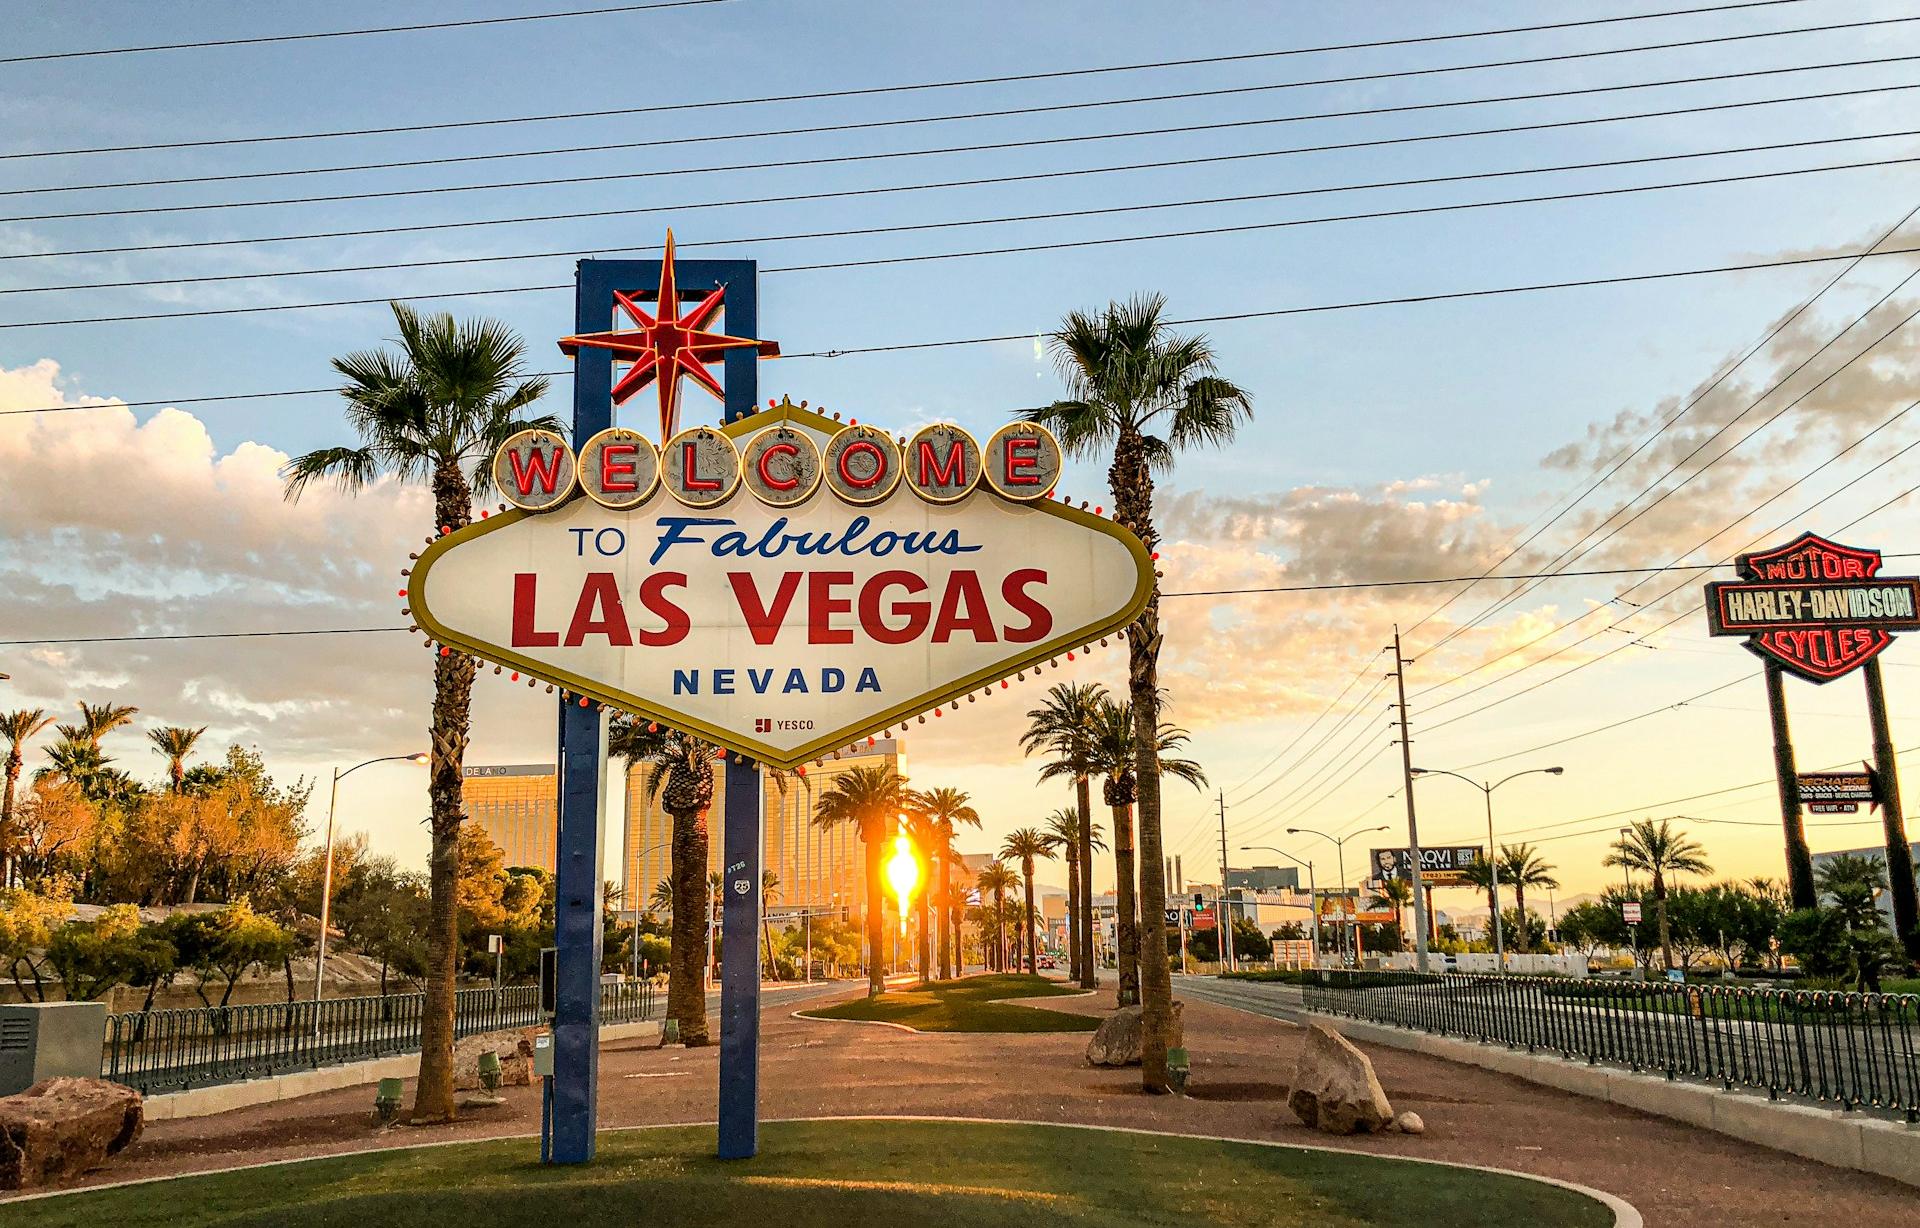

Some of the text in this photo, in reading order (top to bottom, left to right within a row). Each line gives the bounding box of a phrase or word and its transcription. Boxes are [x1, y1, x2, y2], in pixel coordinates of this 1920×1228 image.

[508, 439, 1041, 496] WELCOME
[568, 515, 983, 566] TO Fabulous
[1767, 546, 1864, 580] MOTOR
[511, 569, 1054, 648] LAS VEGAS
[1728, 587, 1913, 622] HARLEY-DAVIDSON
[1774, 627, 1874, 668] CYCLES
[673, 667, 882, 696] NEVADA
[777, 720, 814, 730] YESCO
[466, 767, 507, 776] DELANO
